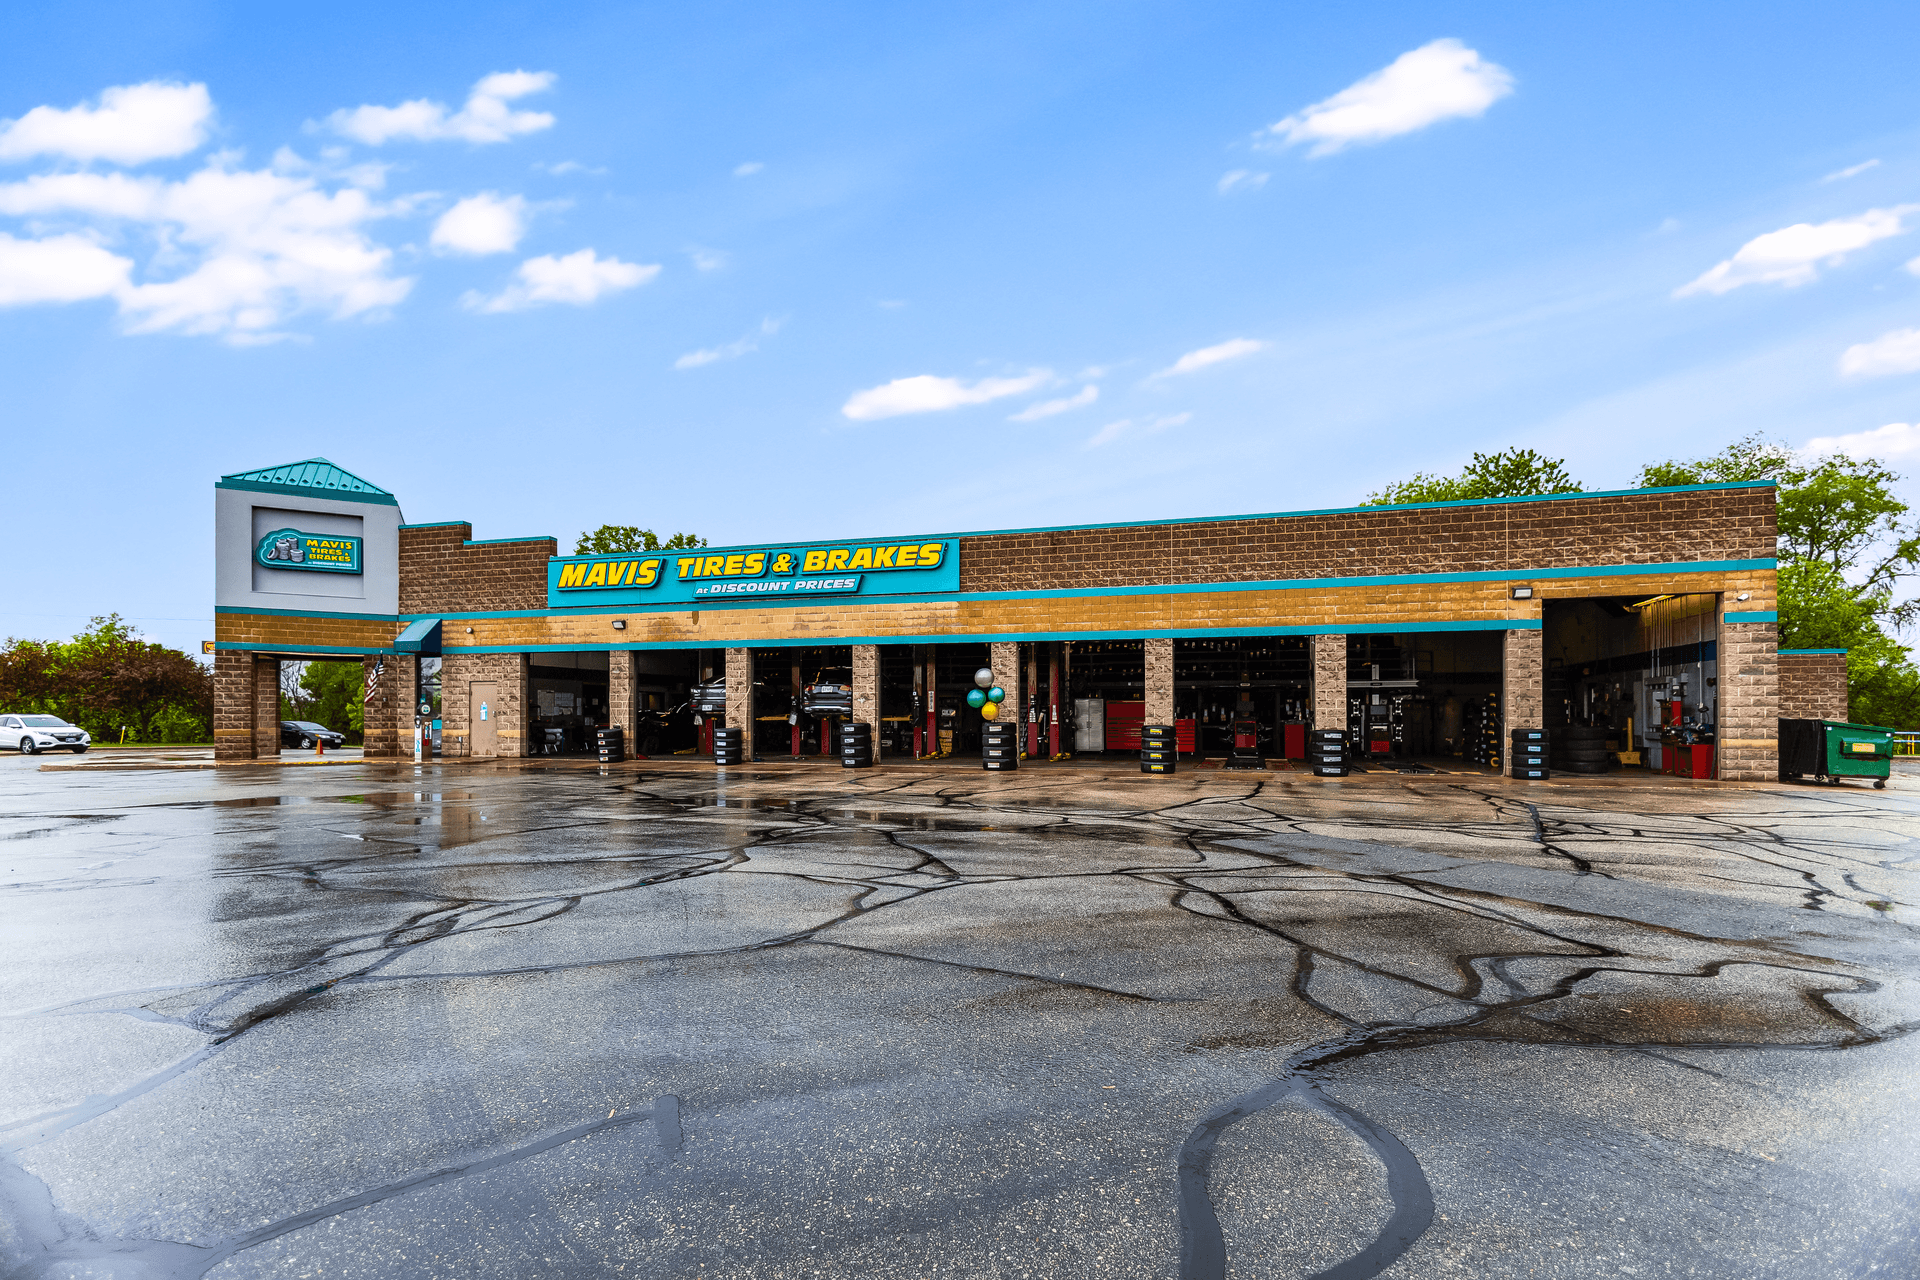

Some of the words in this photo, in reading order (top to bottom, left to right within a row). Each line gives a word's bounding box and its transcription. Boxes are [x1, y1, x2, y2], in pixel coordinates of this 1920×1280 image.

[306, 539, 352, 549] MAVIS
[309, 554, 351, 562] BRAKES
[557, 559, 661, 588] MAVIS
[677, 552, 766, 578] TIRES
[772, 553, 792, 572] &
[802, 543, 943, 572] BRAKES
[710, 581, 790, 593] DISCOUNT
[794, 578, 856, 590] PRICES
